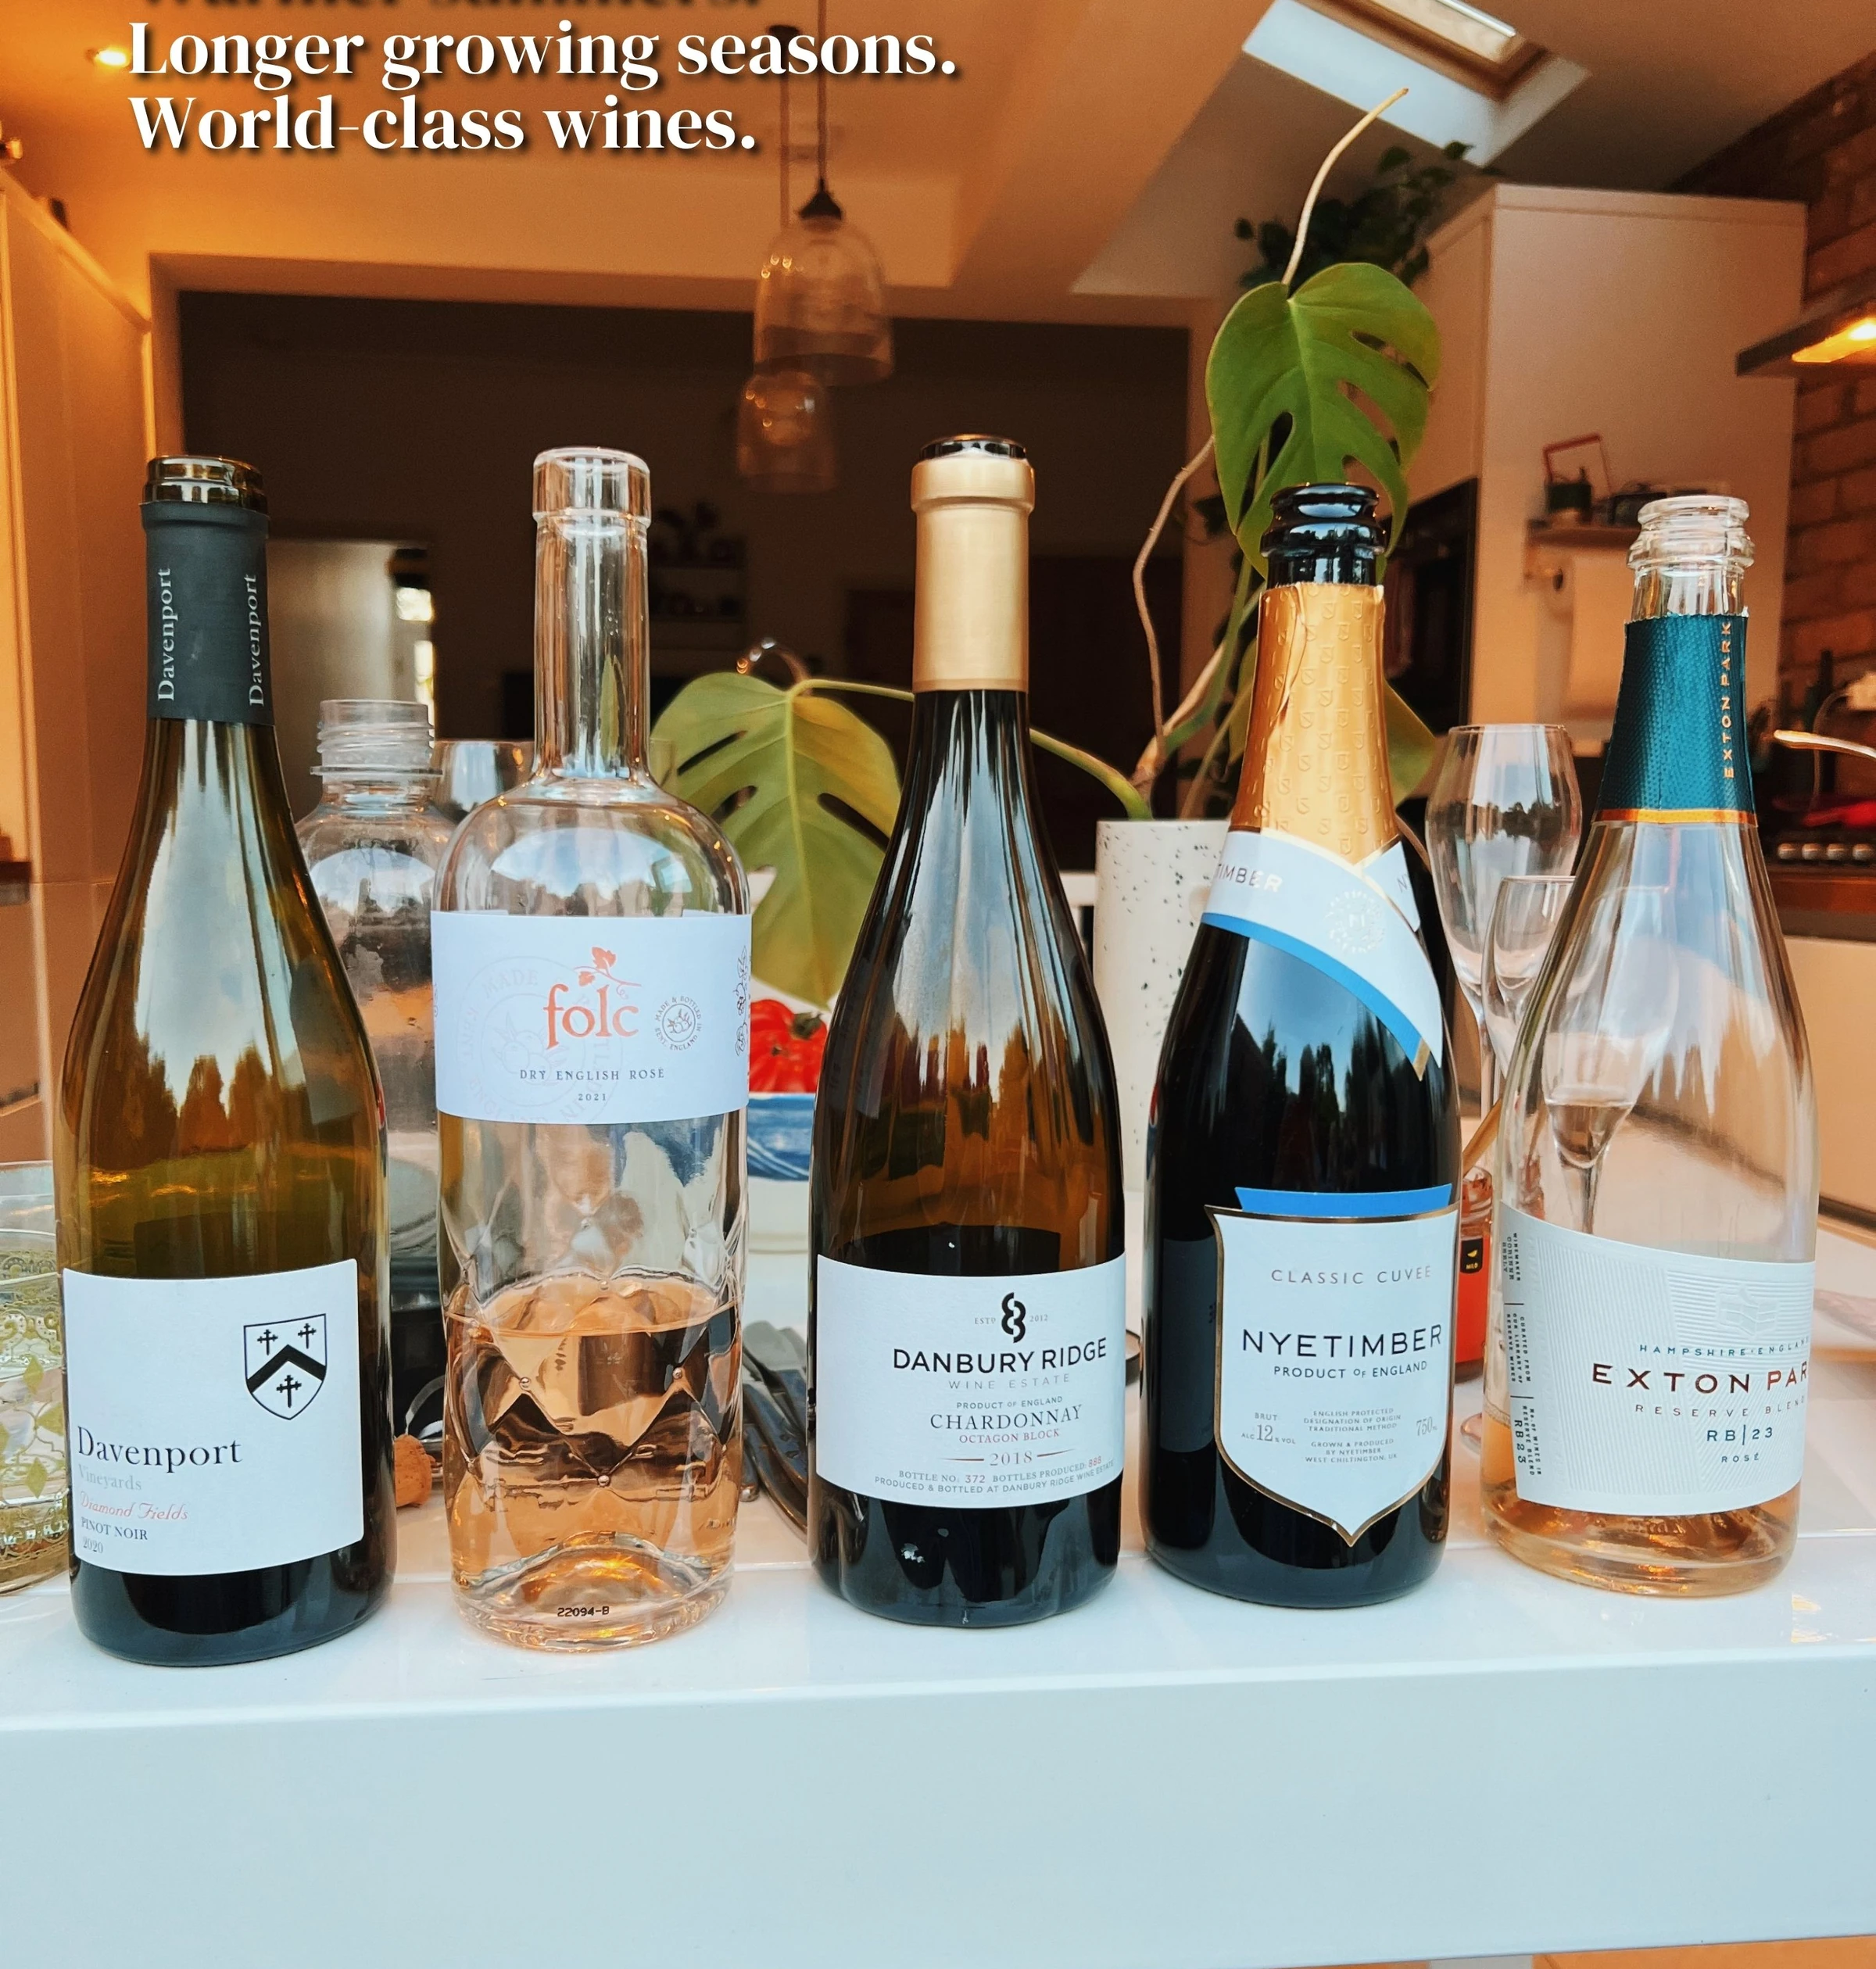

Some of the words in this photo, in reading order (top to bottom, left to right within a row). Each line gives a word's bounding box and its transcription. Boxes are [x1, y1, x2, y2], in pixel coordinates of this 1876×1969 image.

[158, 565, 178, 702] Davenport
[244, 573, 265, 707] Davenport
[1721, 622, 1731, 686] PARK
[1721, 696, 1735, 779] EXTON
[543, 983, 639, 1051] folc
[520, 1069, 546, 1079] DRY
[556, 1070, 619, 1080] ENGLISH
[630, 1067, 665, 1079] ROSÉ
[1271, 1269, 1363, 1284] CLASSIC
[1242, 1324, 1442, 1358] NYETIMBER
[893, 1348, 1035, 1373] DANBURY
[1042, 1337, 1107, 1369] RIDGE
[1273, 1366, 1346, 1379] PRODUCT
[1372, 1360, 1428, 1378] ENGLAND
[1592, 1362, 1751, 1394] EXTON
[1767, 1360, 1807, 1391] PAR
[948, 1380, 996, 1389] WINE
[1008, 1373, 1071, 1389] ESTATE
[1021, 1396, 1064, 1408] ENGLAND
[1635, 1405, 1749, 1417] RESERVE
[930, 1404, 1083, 1430] CHARDONNAY
[1255, 1412, 1278, 1421] BRUT
[959, 1434, 1019, 1444] OCTAGON
[1023, 1428, 1060, 1441] BLOCK
[1355, 1438, 1394, 1447] PRODUCED
[78, 1426, 244, 1473] Davenport
[990, 1451, 1033, 1466] 2018
[1721, 1452, 1760, 1463] ROSÉ
[79, 1464, 142, 1491] Vineyards
[875, 1477, 925, 1491] PRODUCED
[938, 1485, 983, 1494] BOTTLED
[1003, 1480, 1047, 1492] DANBURY
[1050, 1475, 1075, 1487] RIDGE
[1076, 1470, 1094, 1480] WINE
[899, 1470, 938, 1481] BOTTLE
[965, 1475, 986, 1484] 372
[993, 1472, 1036, 1483] BOTTLES
[81, 1491, 137, 1518] Diamond
[81, 1516, 111, 1535] PINOT
[114, 1527, 148, 1541] NOIR
[83, 1538, 104, 1554] 2020
[557, 1606, 610, 1617] 22094-B
